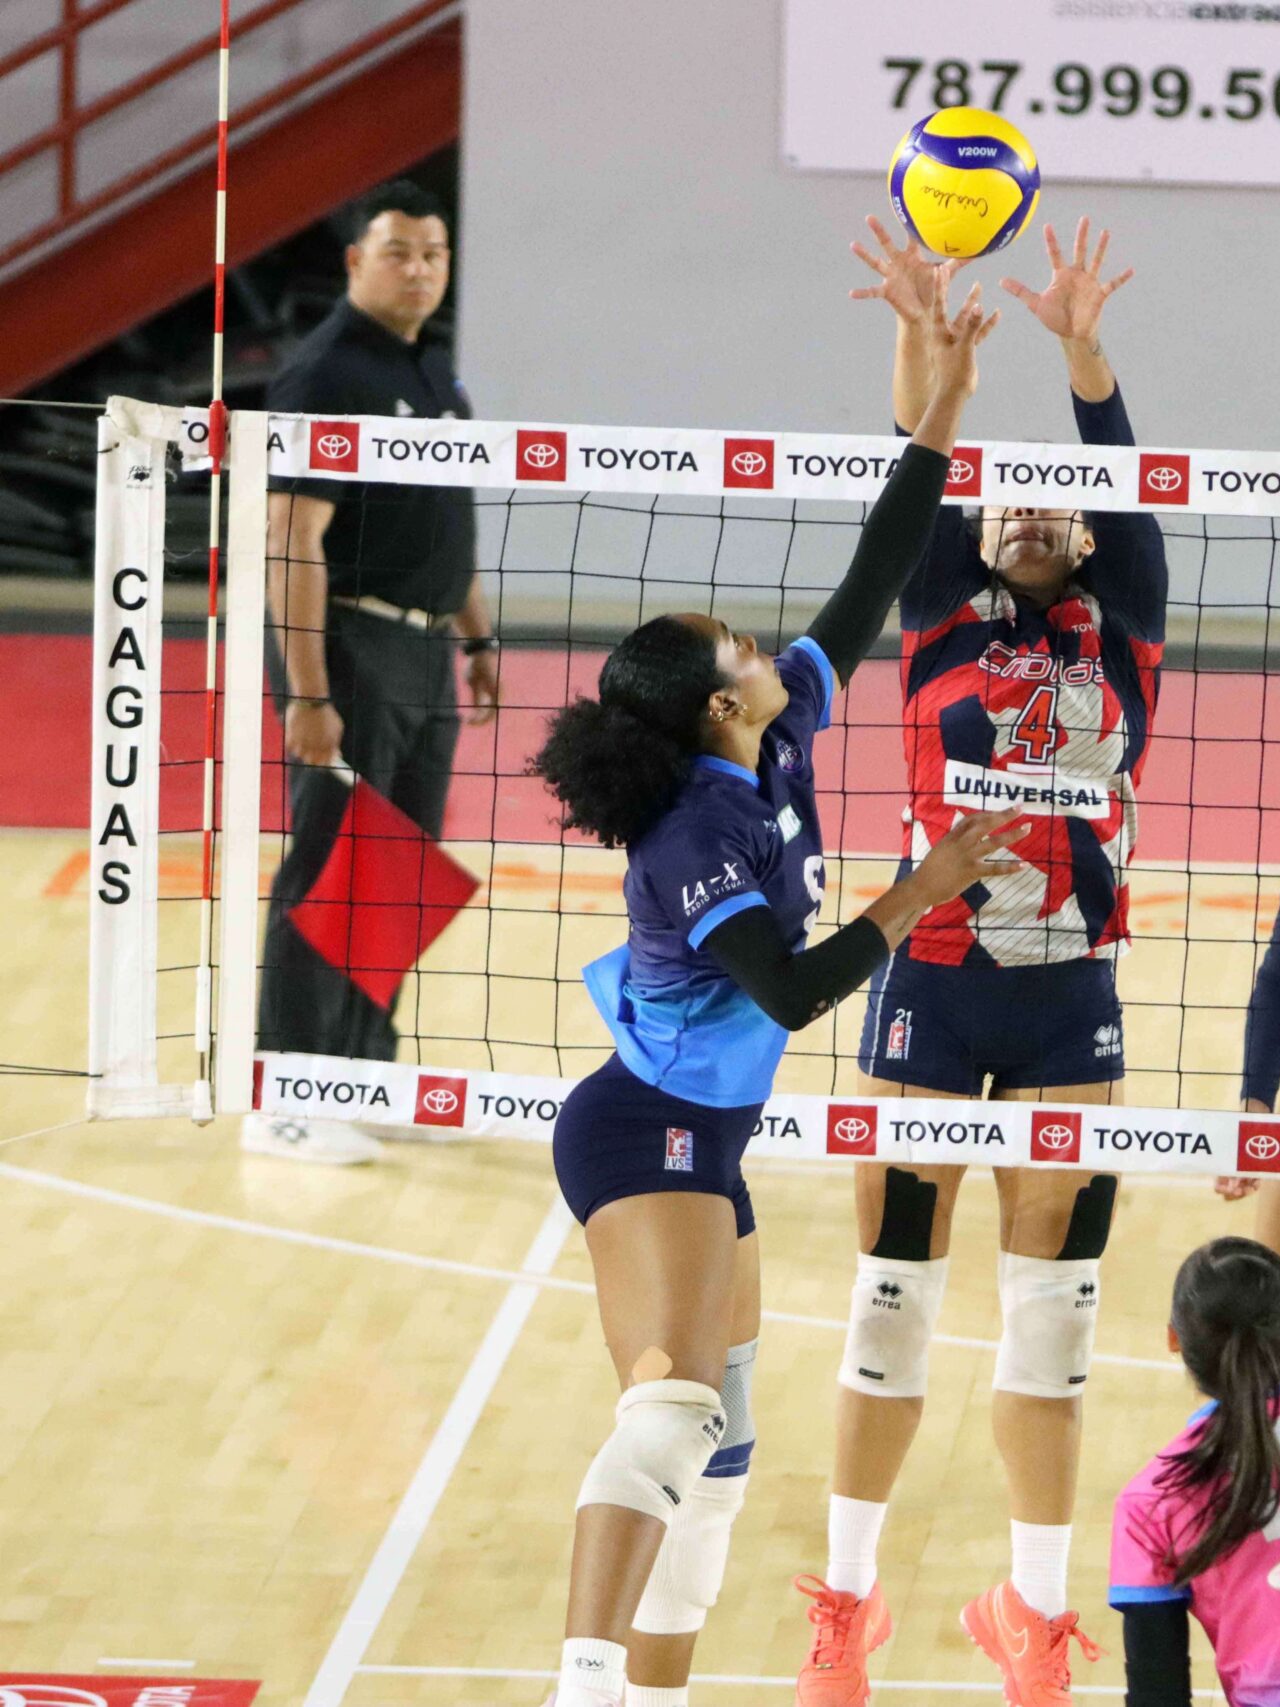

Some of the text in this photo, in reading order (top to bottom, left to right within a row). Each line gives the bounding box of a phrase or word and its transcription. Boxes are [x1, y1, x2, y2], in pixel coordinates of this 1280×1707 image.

[958, 147, 998, 157] V200W
[372, 439, 489, 463] TOYOTA
[579, 448, 697, 472] TOYOTA
[995, 463, 1113, 487] TOYOTA
[98, 567, 148, 905] CAGUAS
[1009, 684, 1059, 765] 4
[954, 775, 1103, 808] UNIVERSAL
[685, 894, 711, 917] RADIO
[894, 1007, 913, 1026] 21
[276, 1077, 390, 1107] TOYOTA
[478, 1094, 565, 1121] TOYO
[890, 1121, 1005, 1145] TOYOTA
[1094, 1129, 1212, 1154] TOYOTA
[665, 1157, 686, 1169] LVS
[872, 1296, 901, 1311] errea
